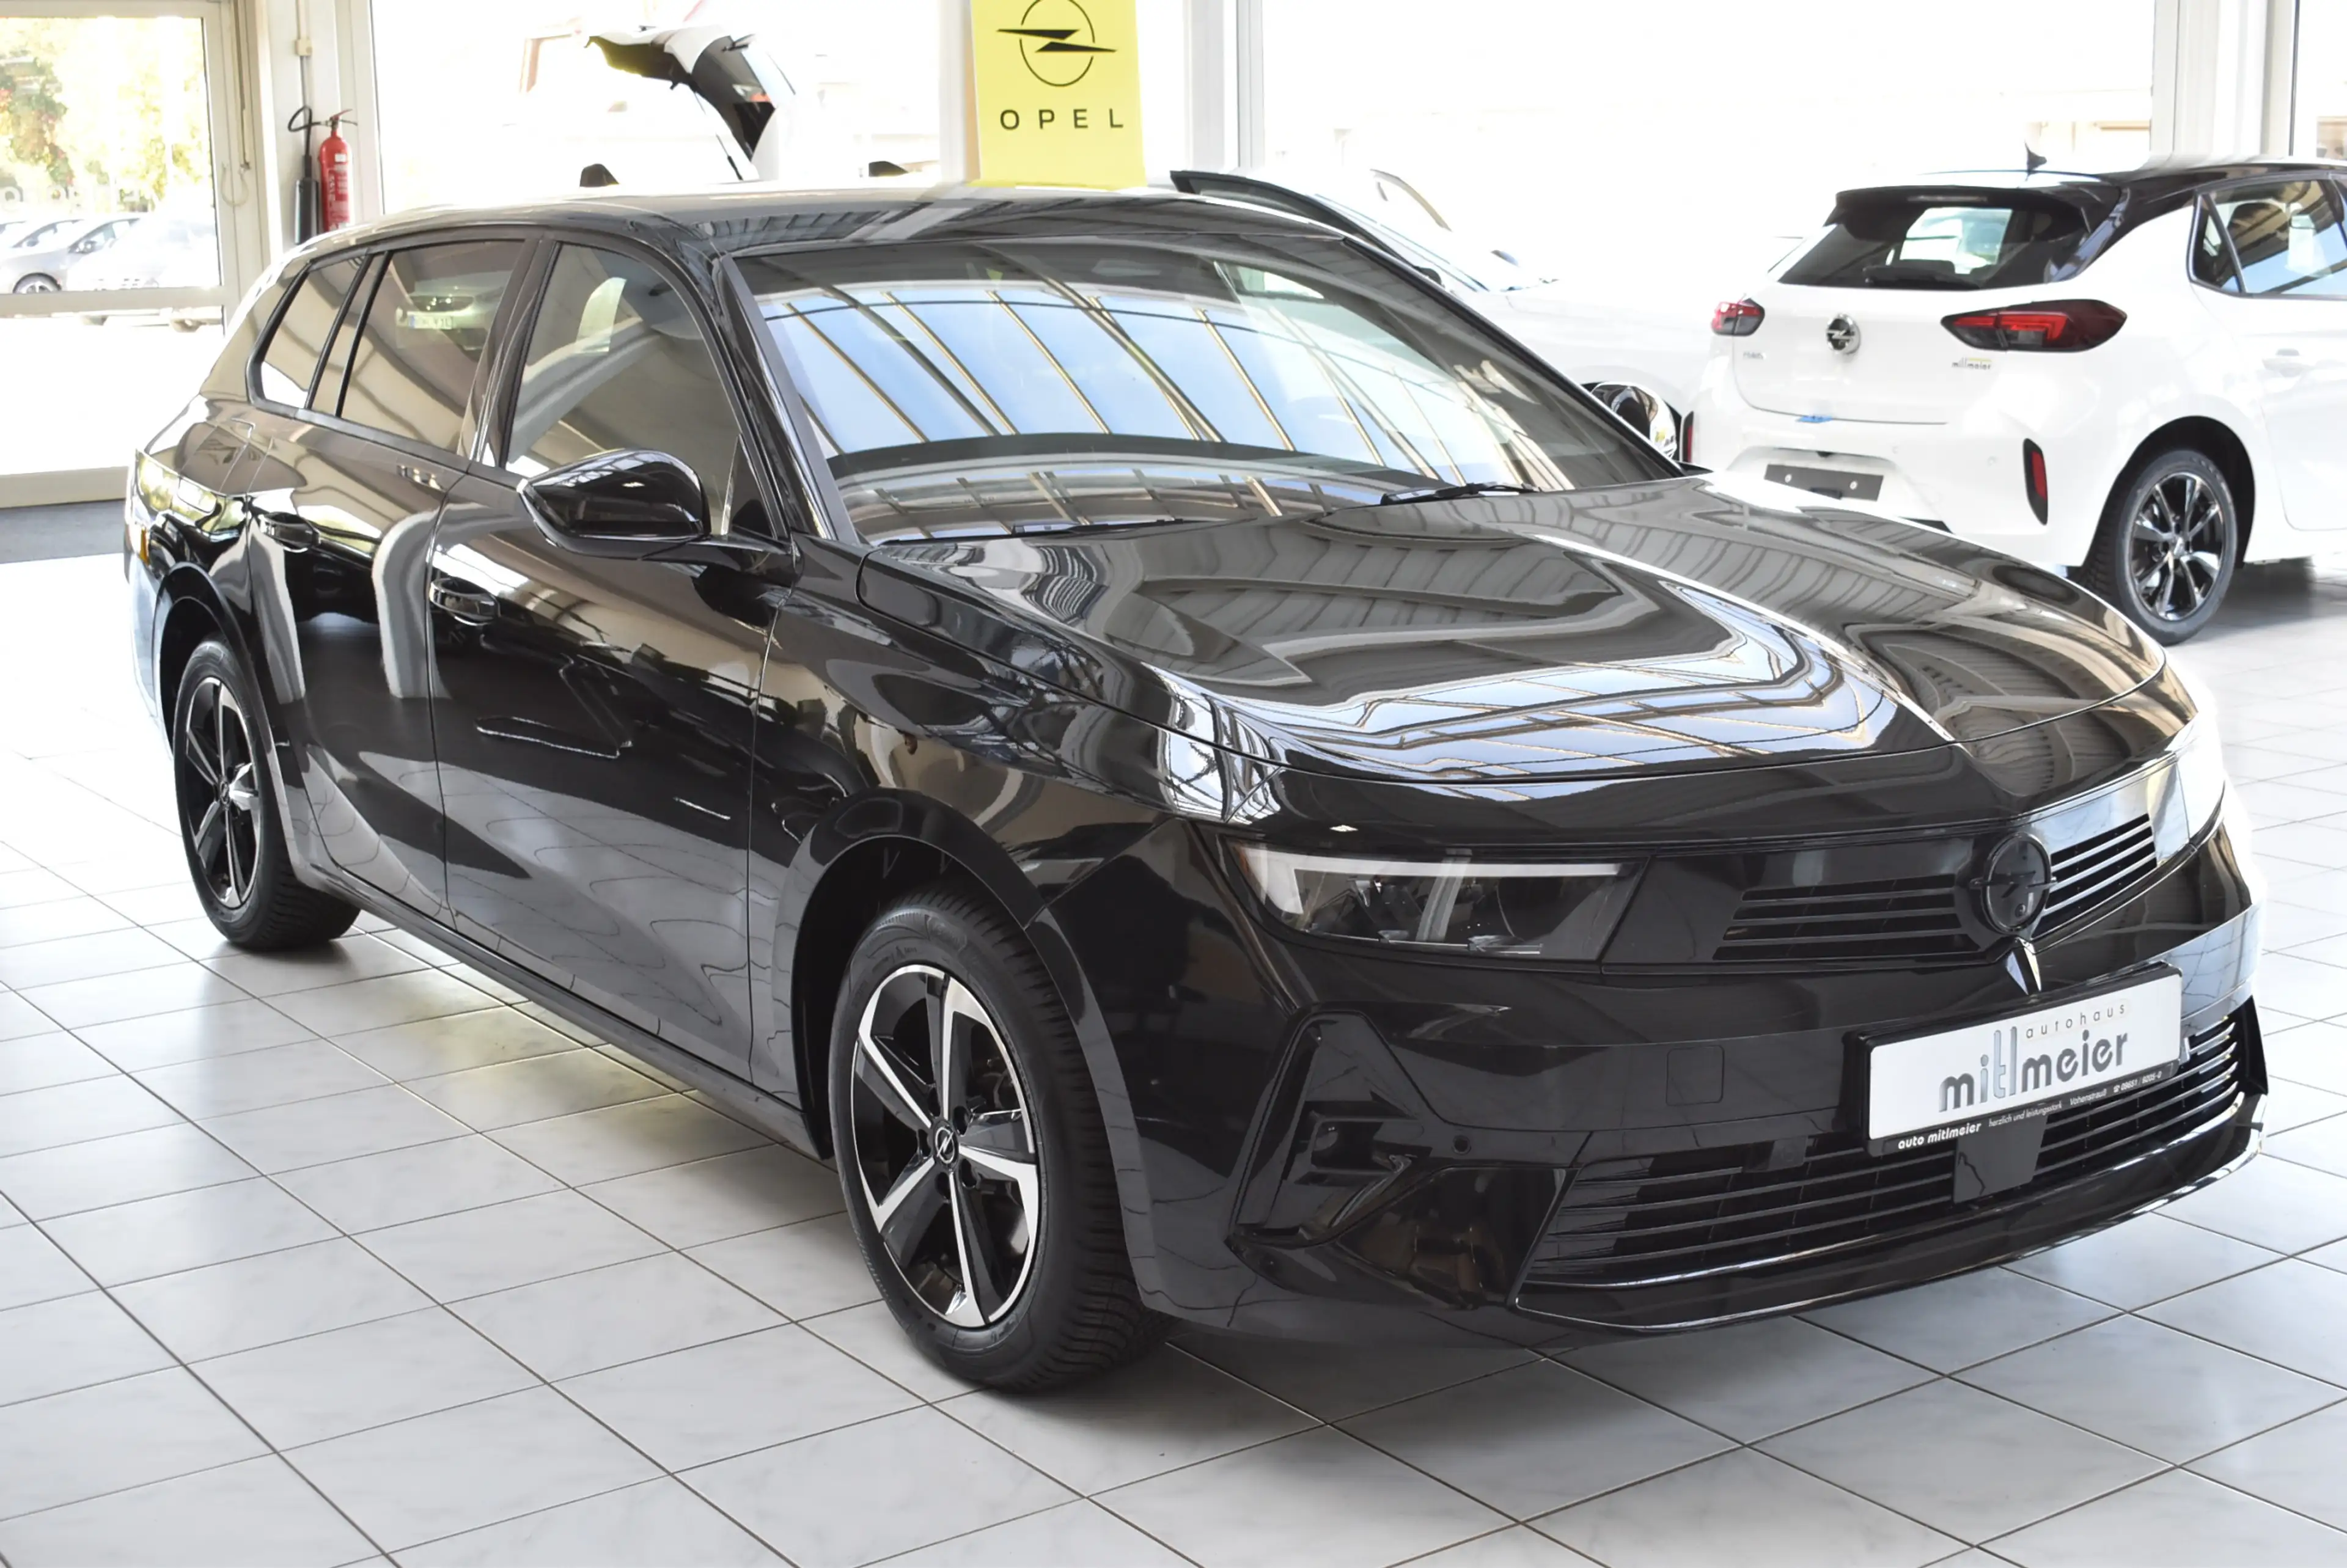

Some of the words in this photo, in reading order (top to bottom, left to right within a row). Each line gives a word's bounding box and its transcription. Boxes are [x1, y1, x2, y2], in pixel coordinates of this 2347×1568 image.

[999, 108, 1124, 131] OPEL
[2026, 1003, 2125, 1039] autohaus
[1939, 1026, 2128, 1113] mitlmeier
[1898, 1135, 1925, 1149] auto
[1927, 1123, 1982, 1144] mitlmeier
[1988, 1113, 2012, 1127] herzlich
[2013, 1109, 2026, 1121] und
